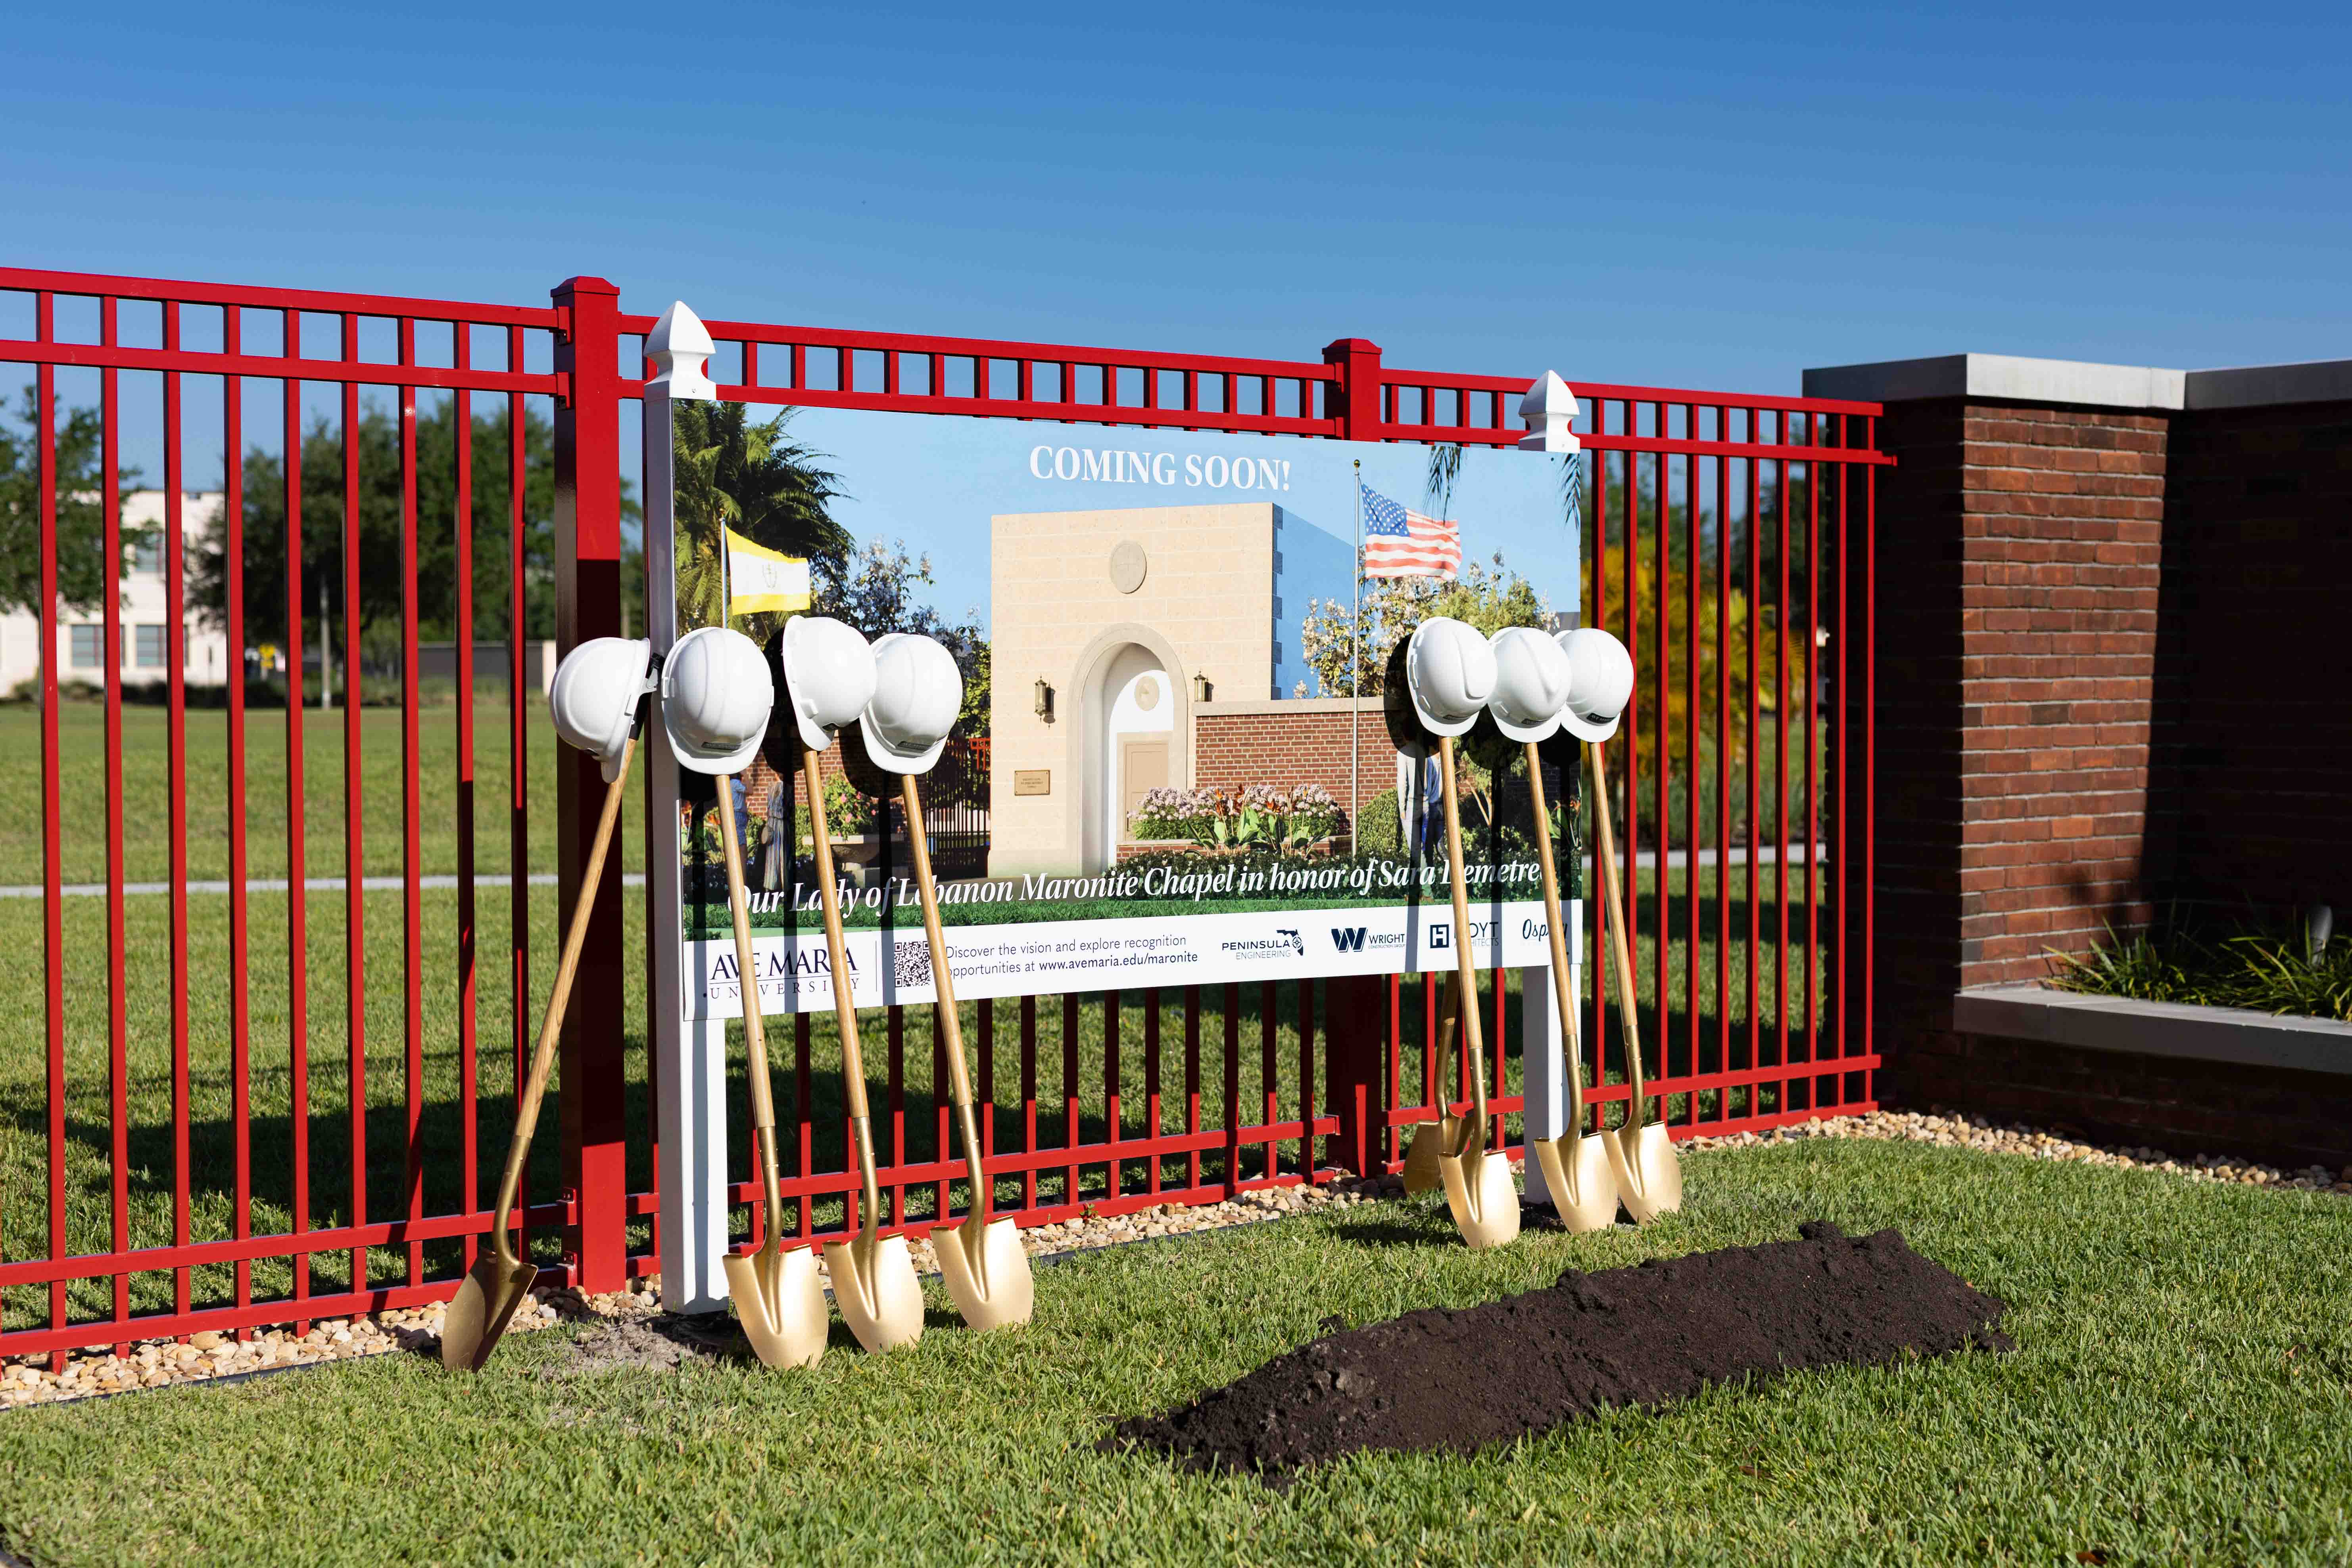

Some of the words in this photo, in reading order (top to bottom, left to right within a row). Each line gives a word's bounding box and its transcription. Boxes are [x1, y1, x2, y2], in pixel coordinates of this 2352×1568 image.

[1030, 445, 1175, 486] COMING
[1185, 454, 1291, 491] SOON!
[866, 877, 896, 917] of
[1018, 870, 1139, 900] Maronite
[1144, 864, 1235, 901] Chapel
[1240, 866, 1264, 892] in
[1269, 863, 1346, 891] honor
[1350, 858, 1378, 896] of
[1378, 860, 1435, 887] Sara
[946, 946, 995, 958] Discover
[998, 942, 1016, 955] the
[1021, 941, 1051, 954] vision
[1056, 939, 1075, 952] and
[1080, 937, 1120, 953] explore
[1125, 934, 1186, 950] recognition
[1222, 940, 1290, 951] PENINSULA
[1369, 934, 1405, 944] WRIGHT
[768, 947, 859, 977] MARA
[1025, 961, 1035, 972] at
[1039, 950, 1198, 971] www.avemaria.edu/maronite
[1236, 950, 1291, 960] ENGINEERING
[710, 978, 859, 999] UNVERSIY
